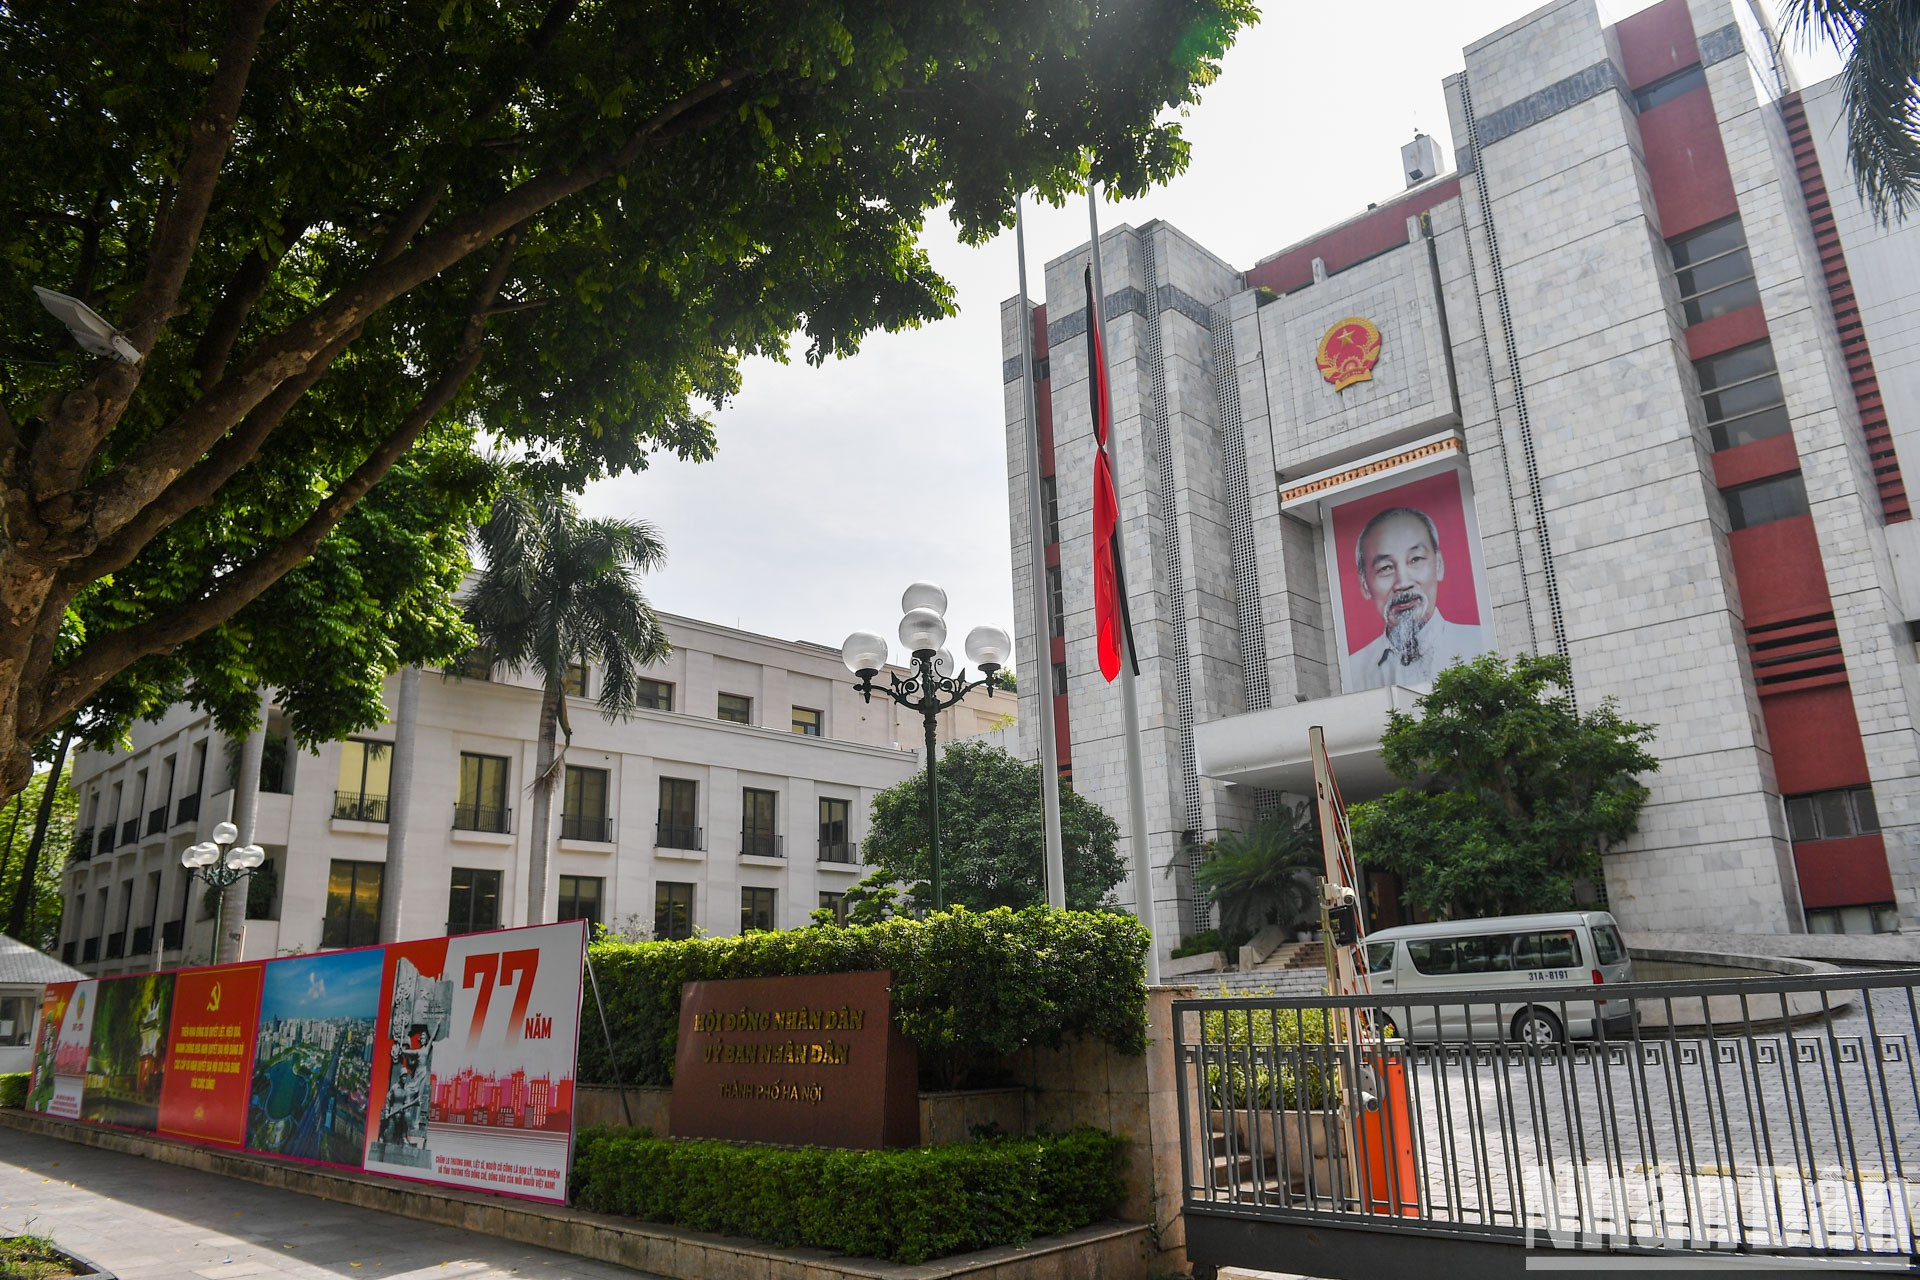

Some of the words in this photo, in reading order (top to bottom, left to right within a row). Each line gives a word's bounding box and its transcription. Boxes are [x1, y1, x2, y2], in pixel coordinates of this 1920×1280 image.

[1528, 970, 1568, 981] 31A-8191
[463, 948, 540, 1050] 77
[524, 1013, 552, 1039] NĂM
[693, 1008, 723, 1036] HỘI
[725, 1005, 771, 1032] ĐỒNG
[774, 1005, 822, 1031] NHÂN
[825, 1005, 865, 1030] DÂN
[725, 1044, 756, 1064] BAN
[760, 1040, 808, 1064] NHÂN
[810, 1039, 849, 1064] DÂN
[719, 1080, 752, 1099] THÀNH
[757, 1079, 782, 1100] PHỐ
[783, 1082, 798, 1100] HÀ
[801, 1081, 823, 1105] NỘI
